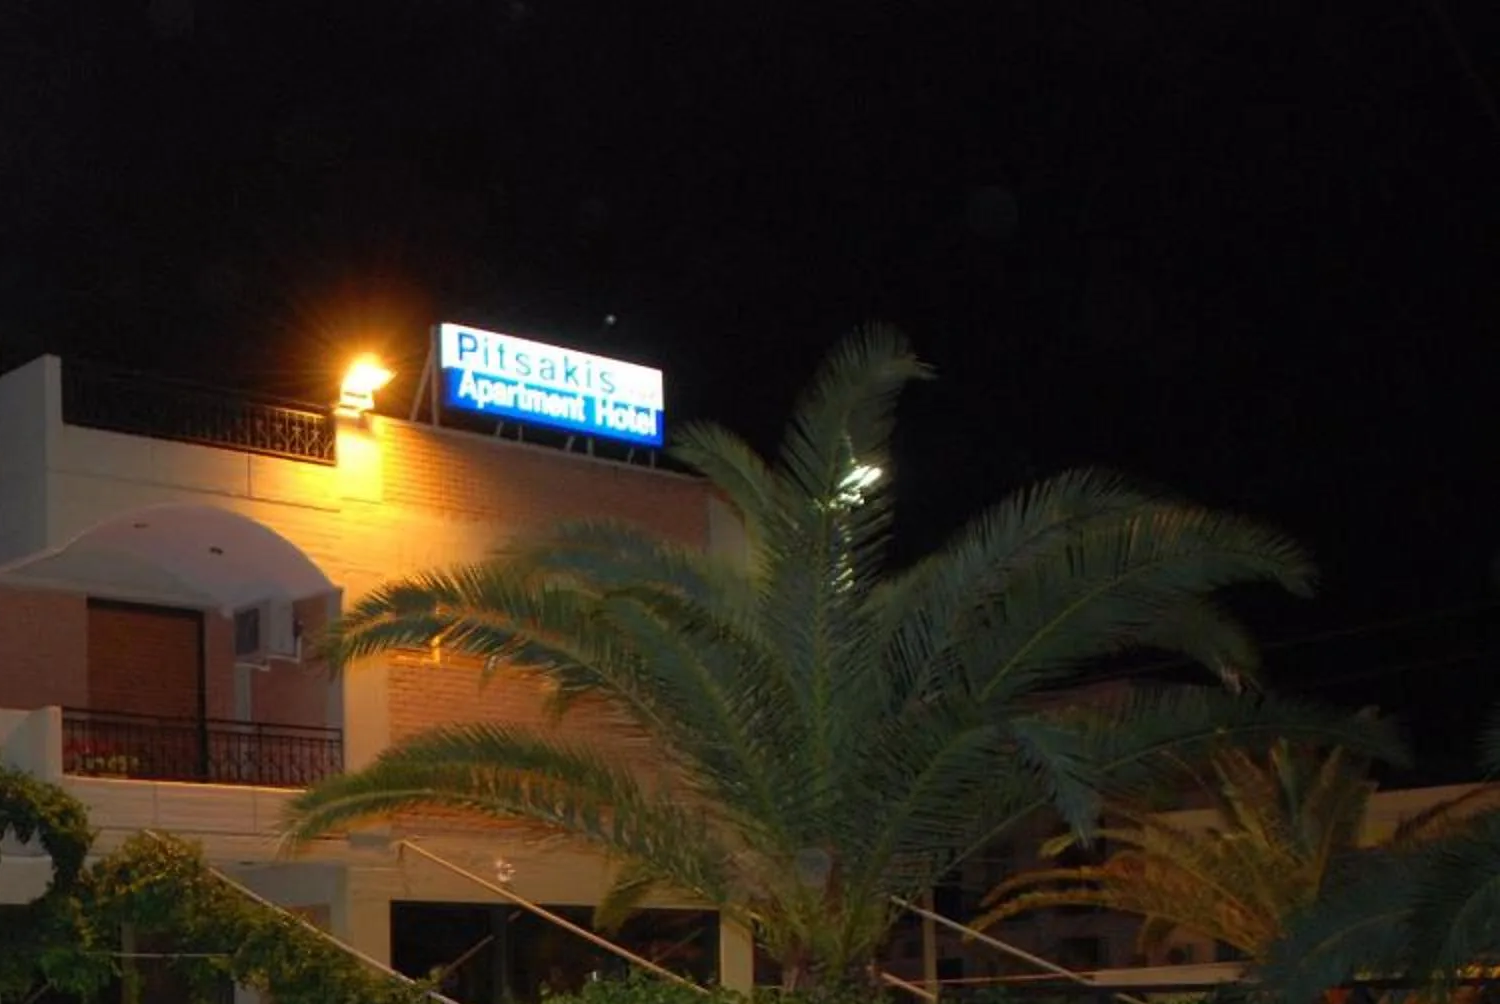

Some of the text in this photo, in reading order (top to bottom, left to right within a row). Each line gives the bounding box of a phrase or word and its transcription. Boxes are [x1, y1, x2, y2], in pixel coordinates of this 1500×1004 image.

[458, 333, 616, 395] Pitsakis
[459, 370, 656, 436] Apartment Hotel
